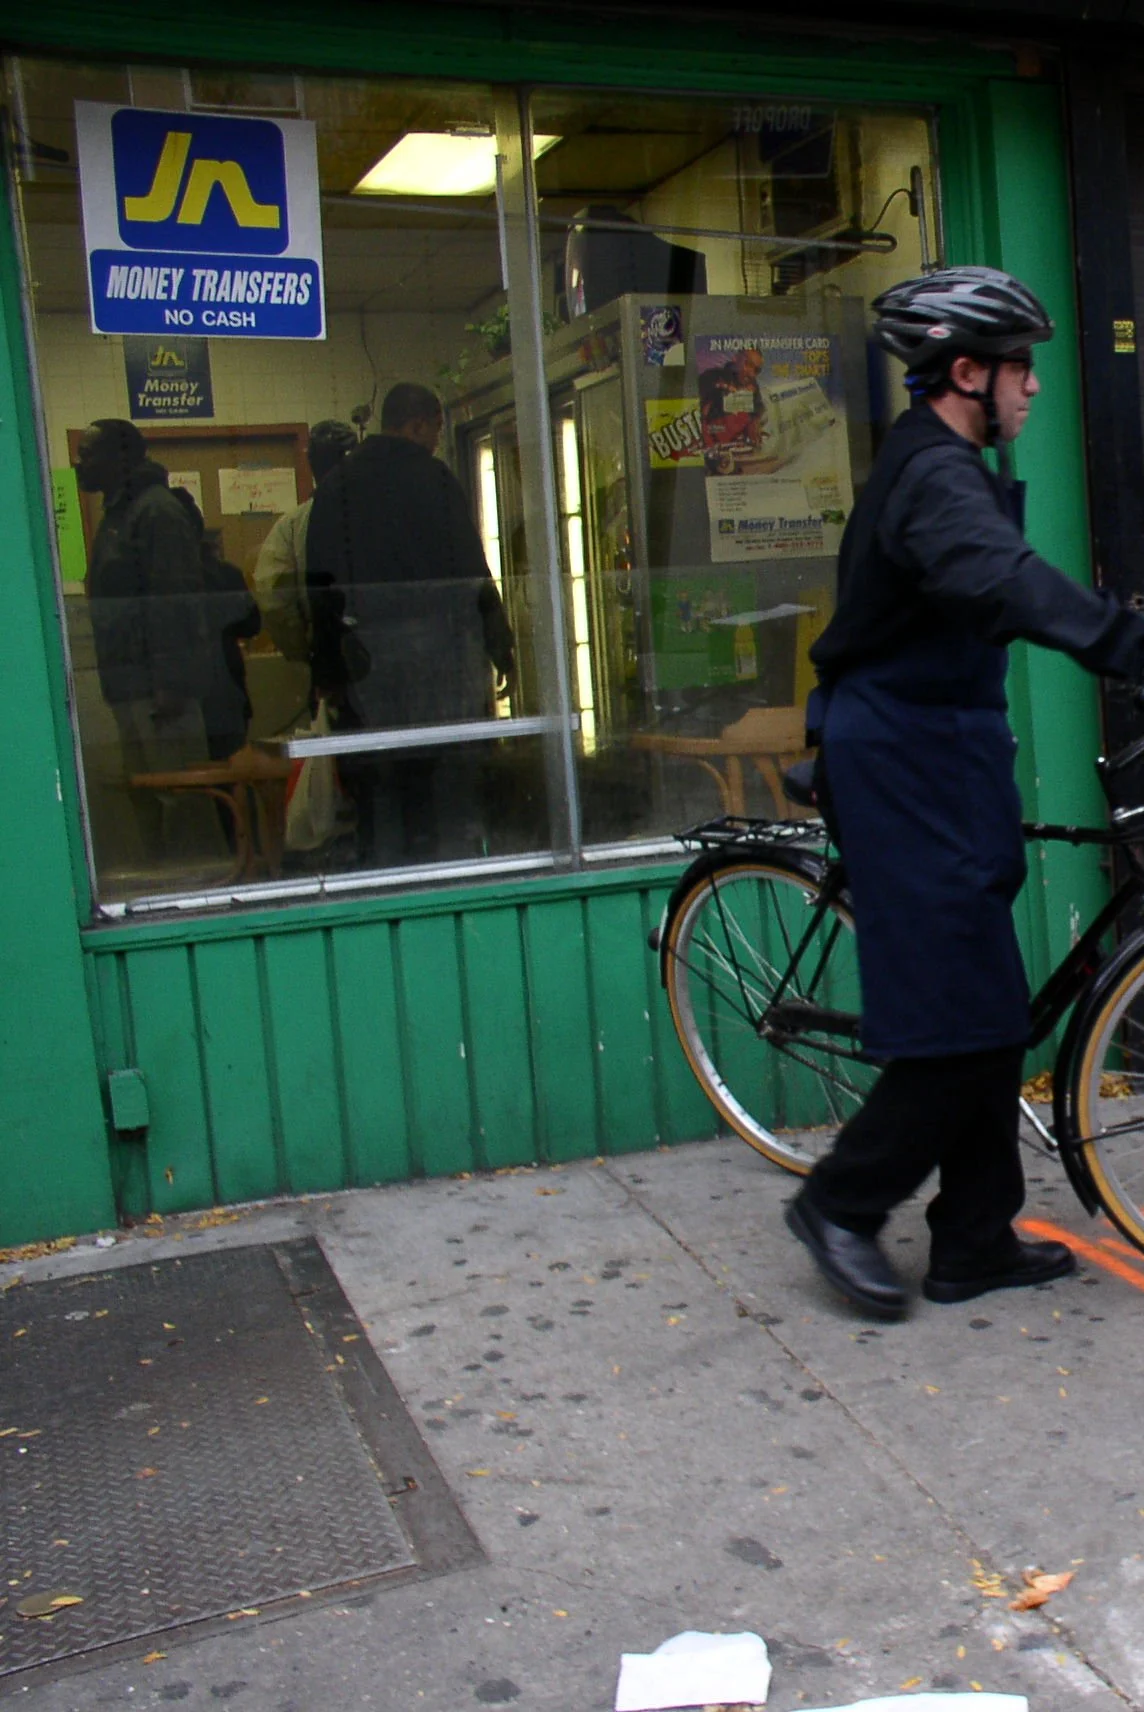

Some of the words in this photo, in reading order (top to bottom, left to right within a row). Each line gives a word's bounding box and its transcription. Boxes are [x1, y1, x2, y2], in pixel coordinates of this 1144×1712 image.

[106, 265, 185, 301] MONEY
[192, 268, 312, 306] TRANSFERS
[164, 309, 194, 326] NO
[202, 310, 256, 327] CASH
[723, 338, 758, 351] MONEY
[760, 337, 804, 349] TRANSFER
[805, 337, 830, 349] CARD
[143, 379, 200, 396] Money
[137, 392, 204, 408] Transfer
